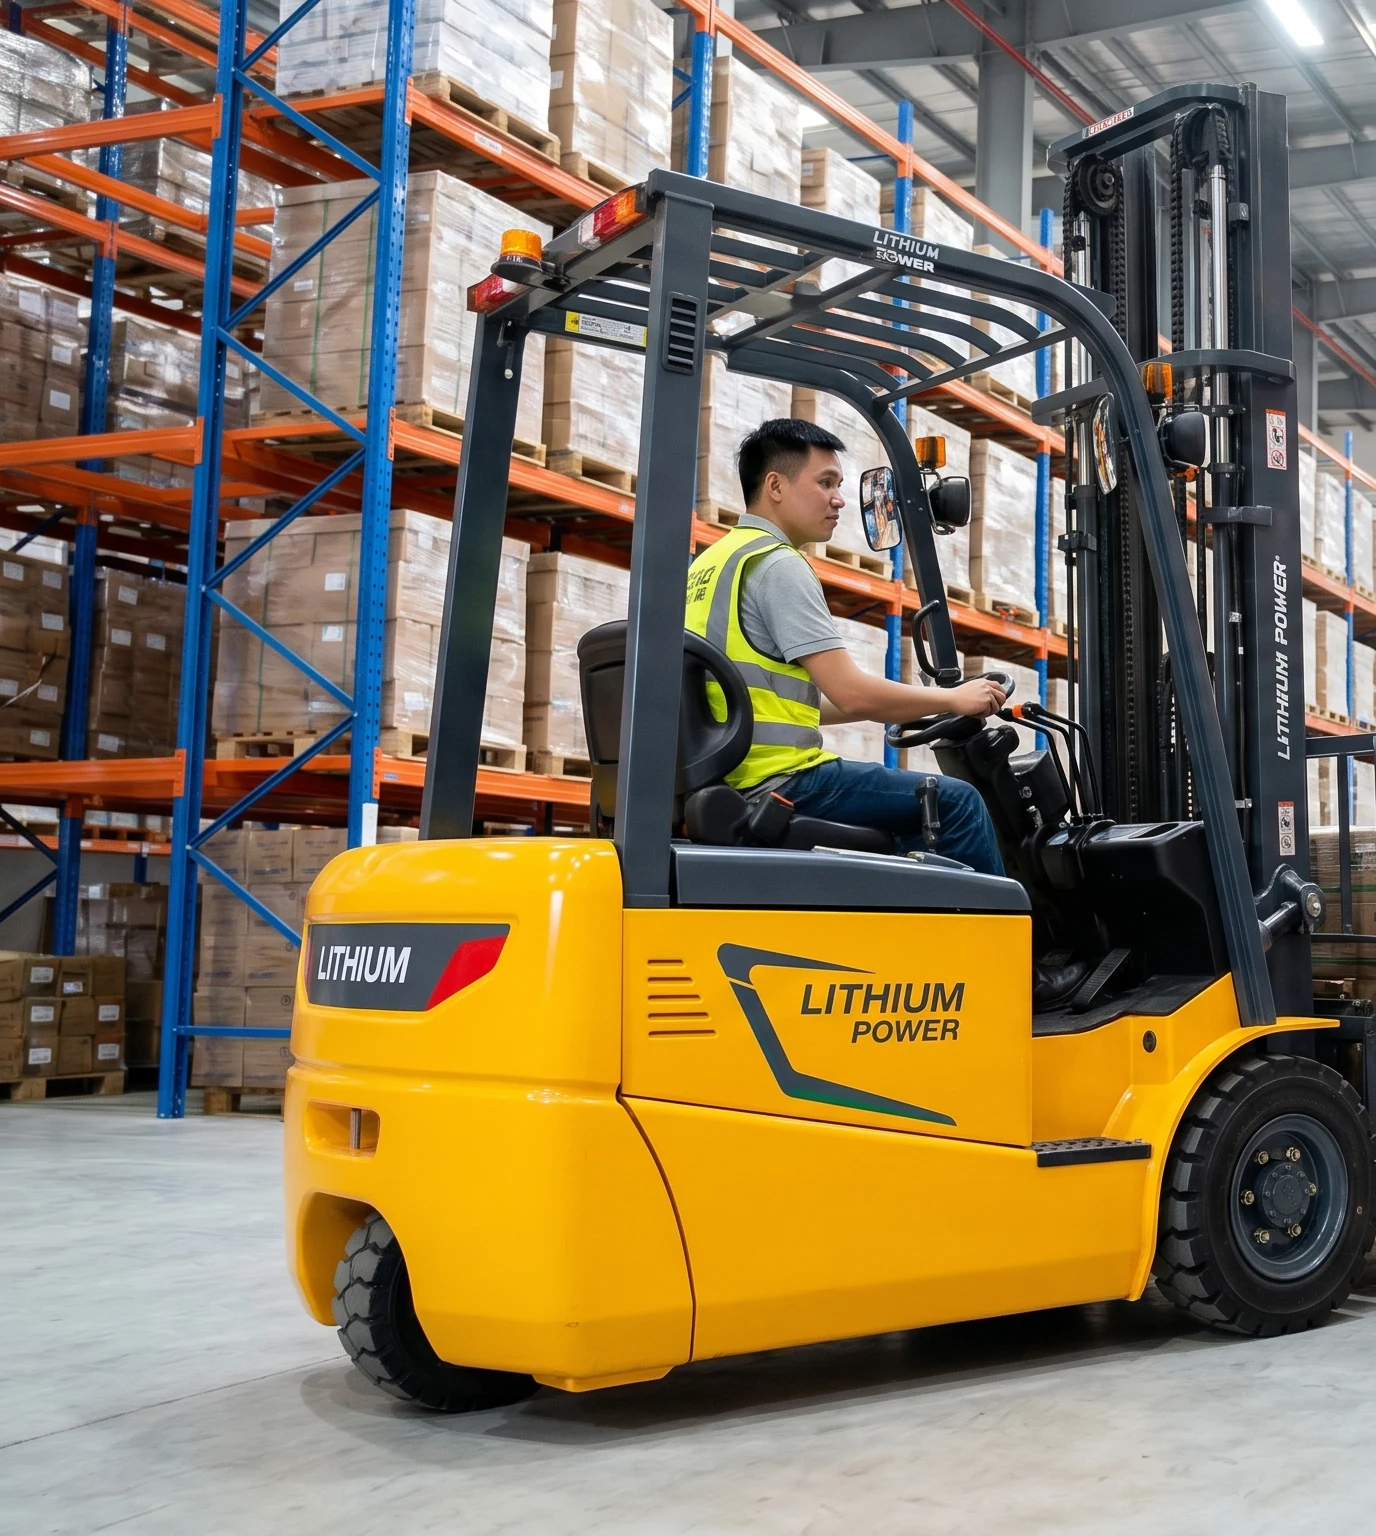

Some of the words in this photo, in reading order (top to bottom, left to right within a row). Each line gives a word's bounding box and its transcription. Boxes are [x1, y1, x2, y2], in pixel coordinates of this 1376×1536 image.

[873, 231, 940, 260] LITHIUM
[1275, 651, 1291, 760] LITHIUM
[317, 945, 412, 984] LITHIUM
[801, 982, 966, 1015] LITHIUM
[851, 1018, 960, 1044] POWER
